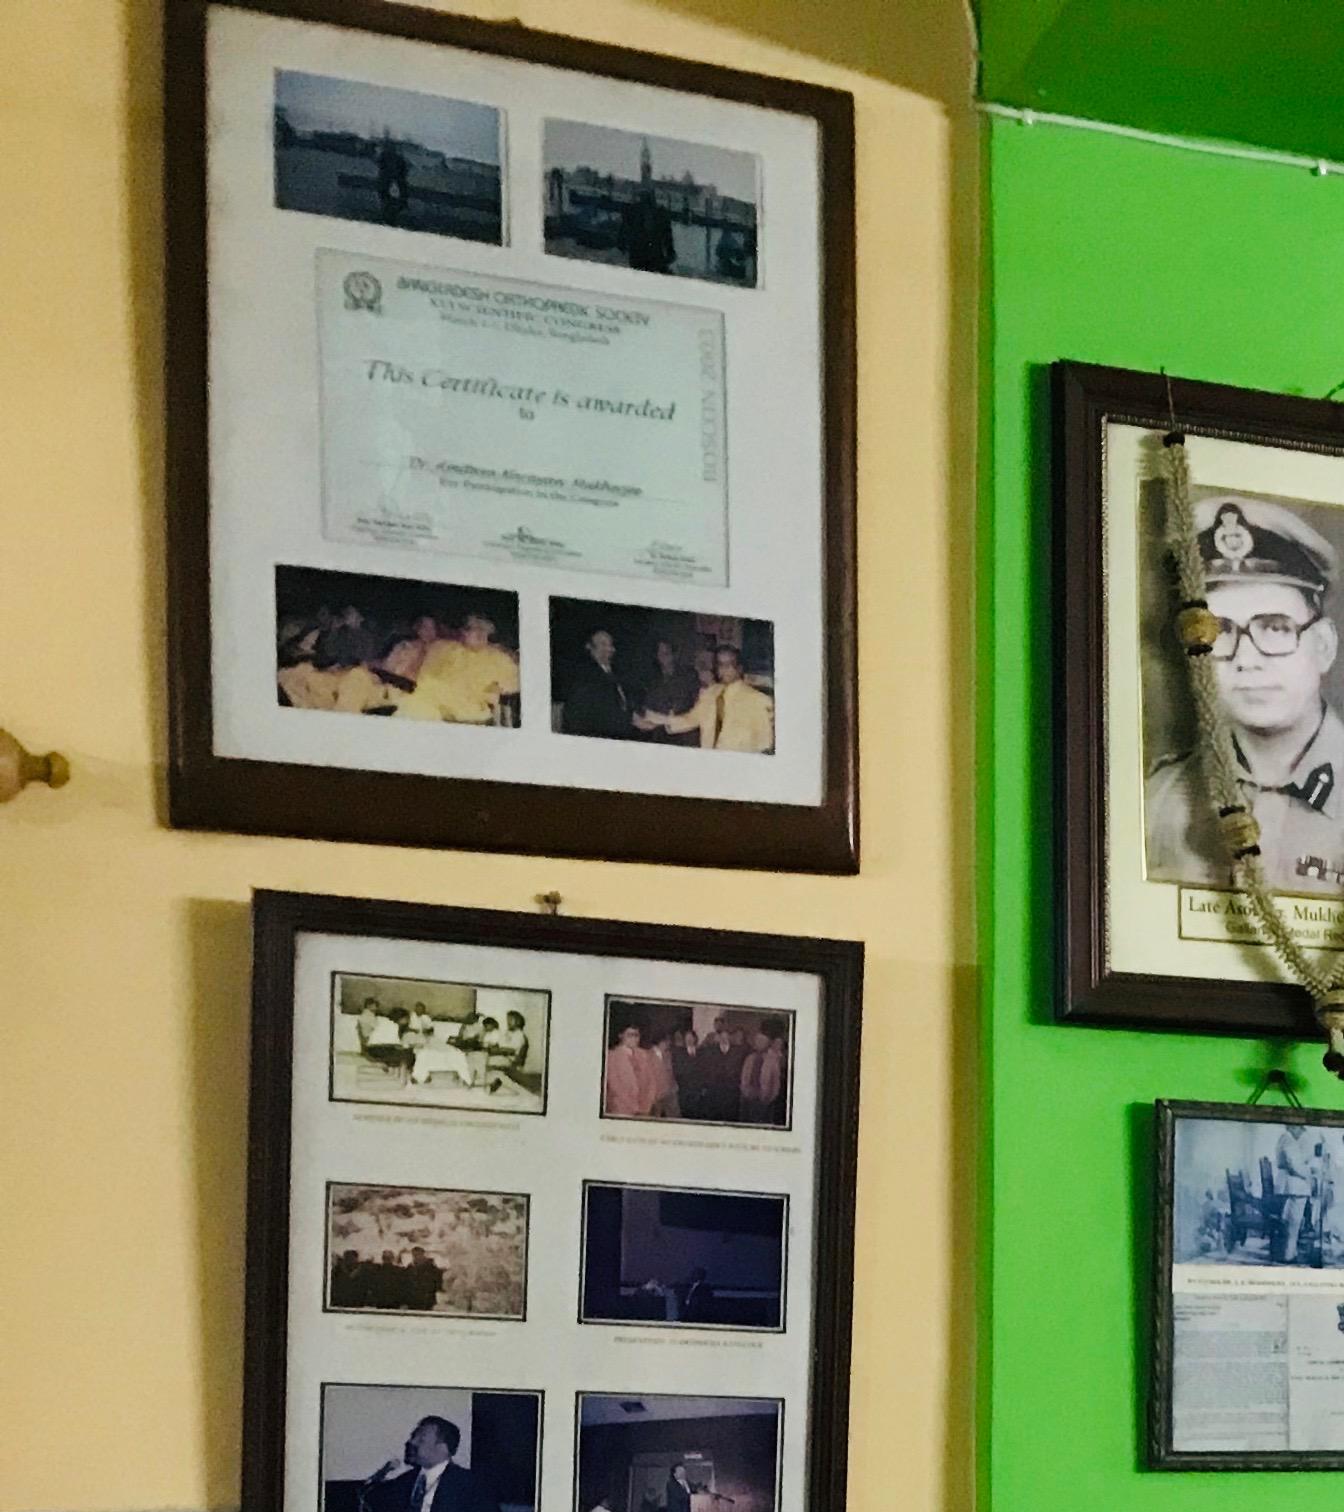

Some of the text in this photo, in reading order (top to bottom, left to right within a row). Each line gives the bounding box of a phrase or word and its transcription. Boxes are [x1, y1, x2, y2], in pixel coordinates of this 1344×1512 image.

[364, 359, 676, 422] This Certificate is awarded
[518, 406, 536, 421] to
[1188, 896, 1221, 914] Late
